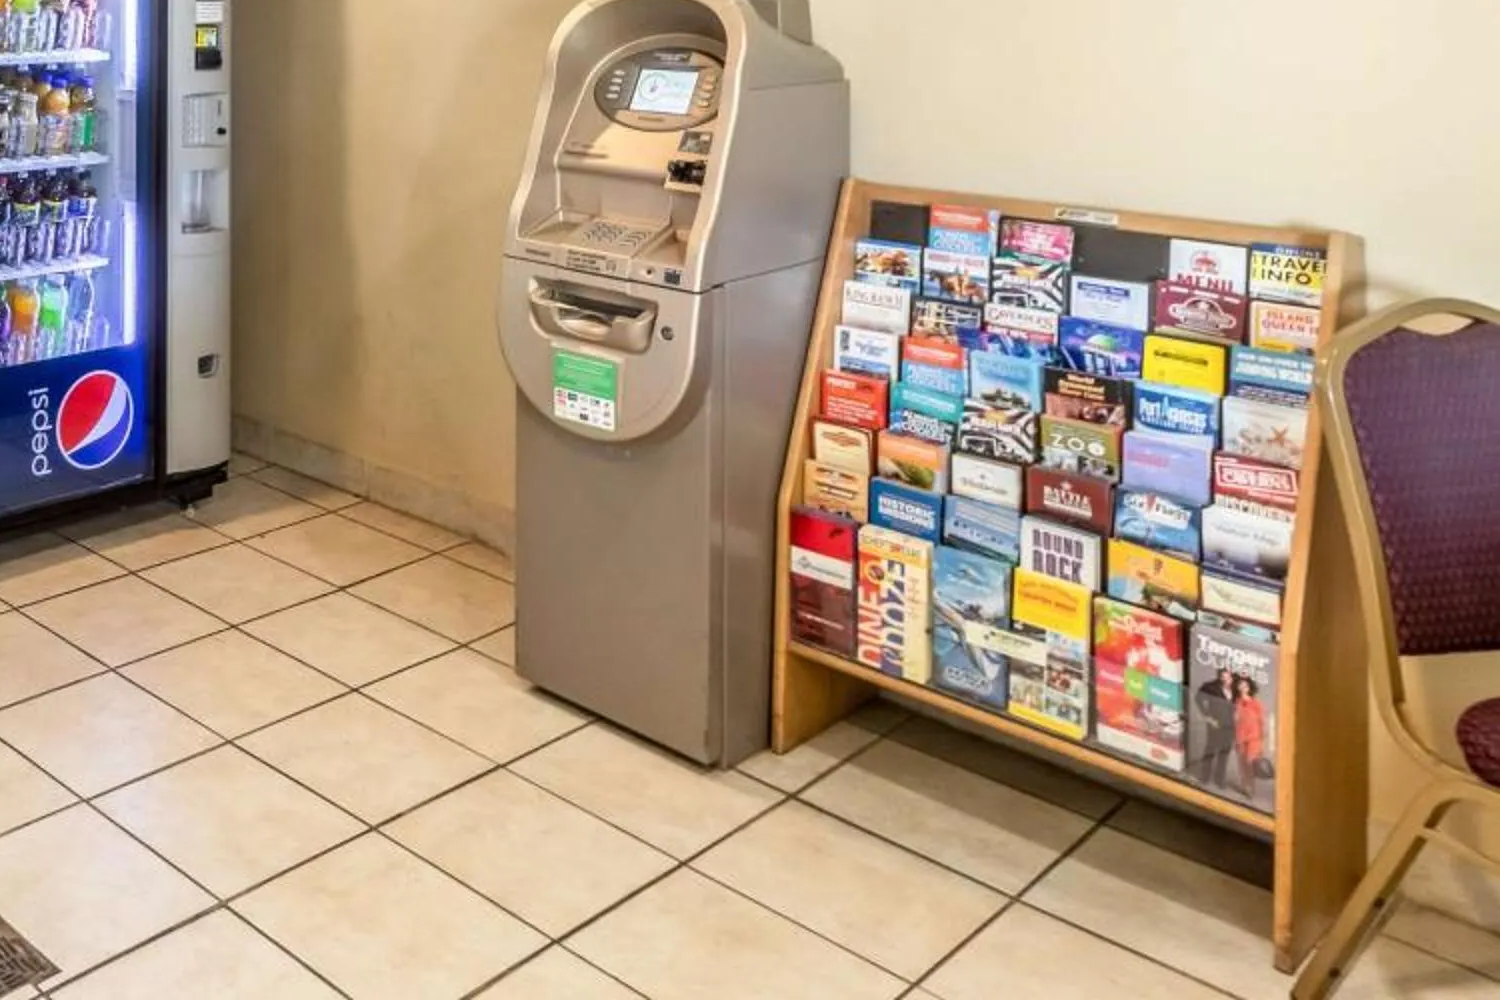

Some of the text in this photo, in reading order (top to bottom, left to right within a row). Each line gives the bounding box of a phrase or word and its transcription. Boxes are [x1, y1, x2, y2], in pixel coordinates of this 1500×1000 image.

[1261, 269, 1312, 286] INFO
[27, 387, 52, 477] pepsi
[1050, 433, 1106, 457] ZOO
[1032, 529, 1084, 560] ROUND
[1032, 550, 1083, 584] ROCK
[1197, 634, 1270, 666] Tanger
